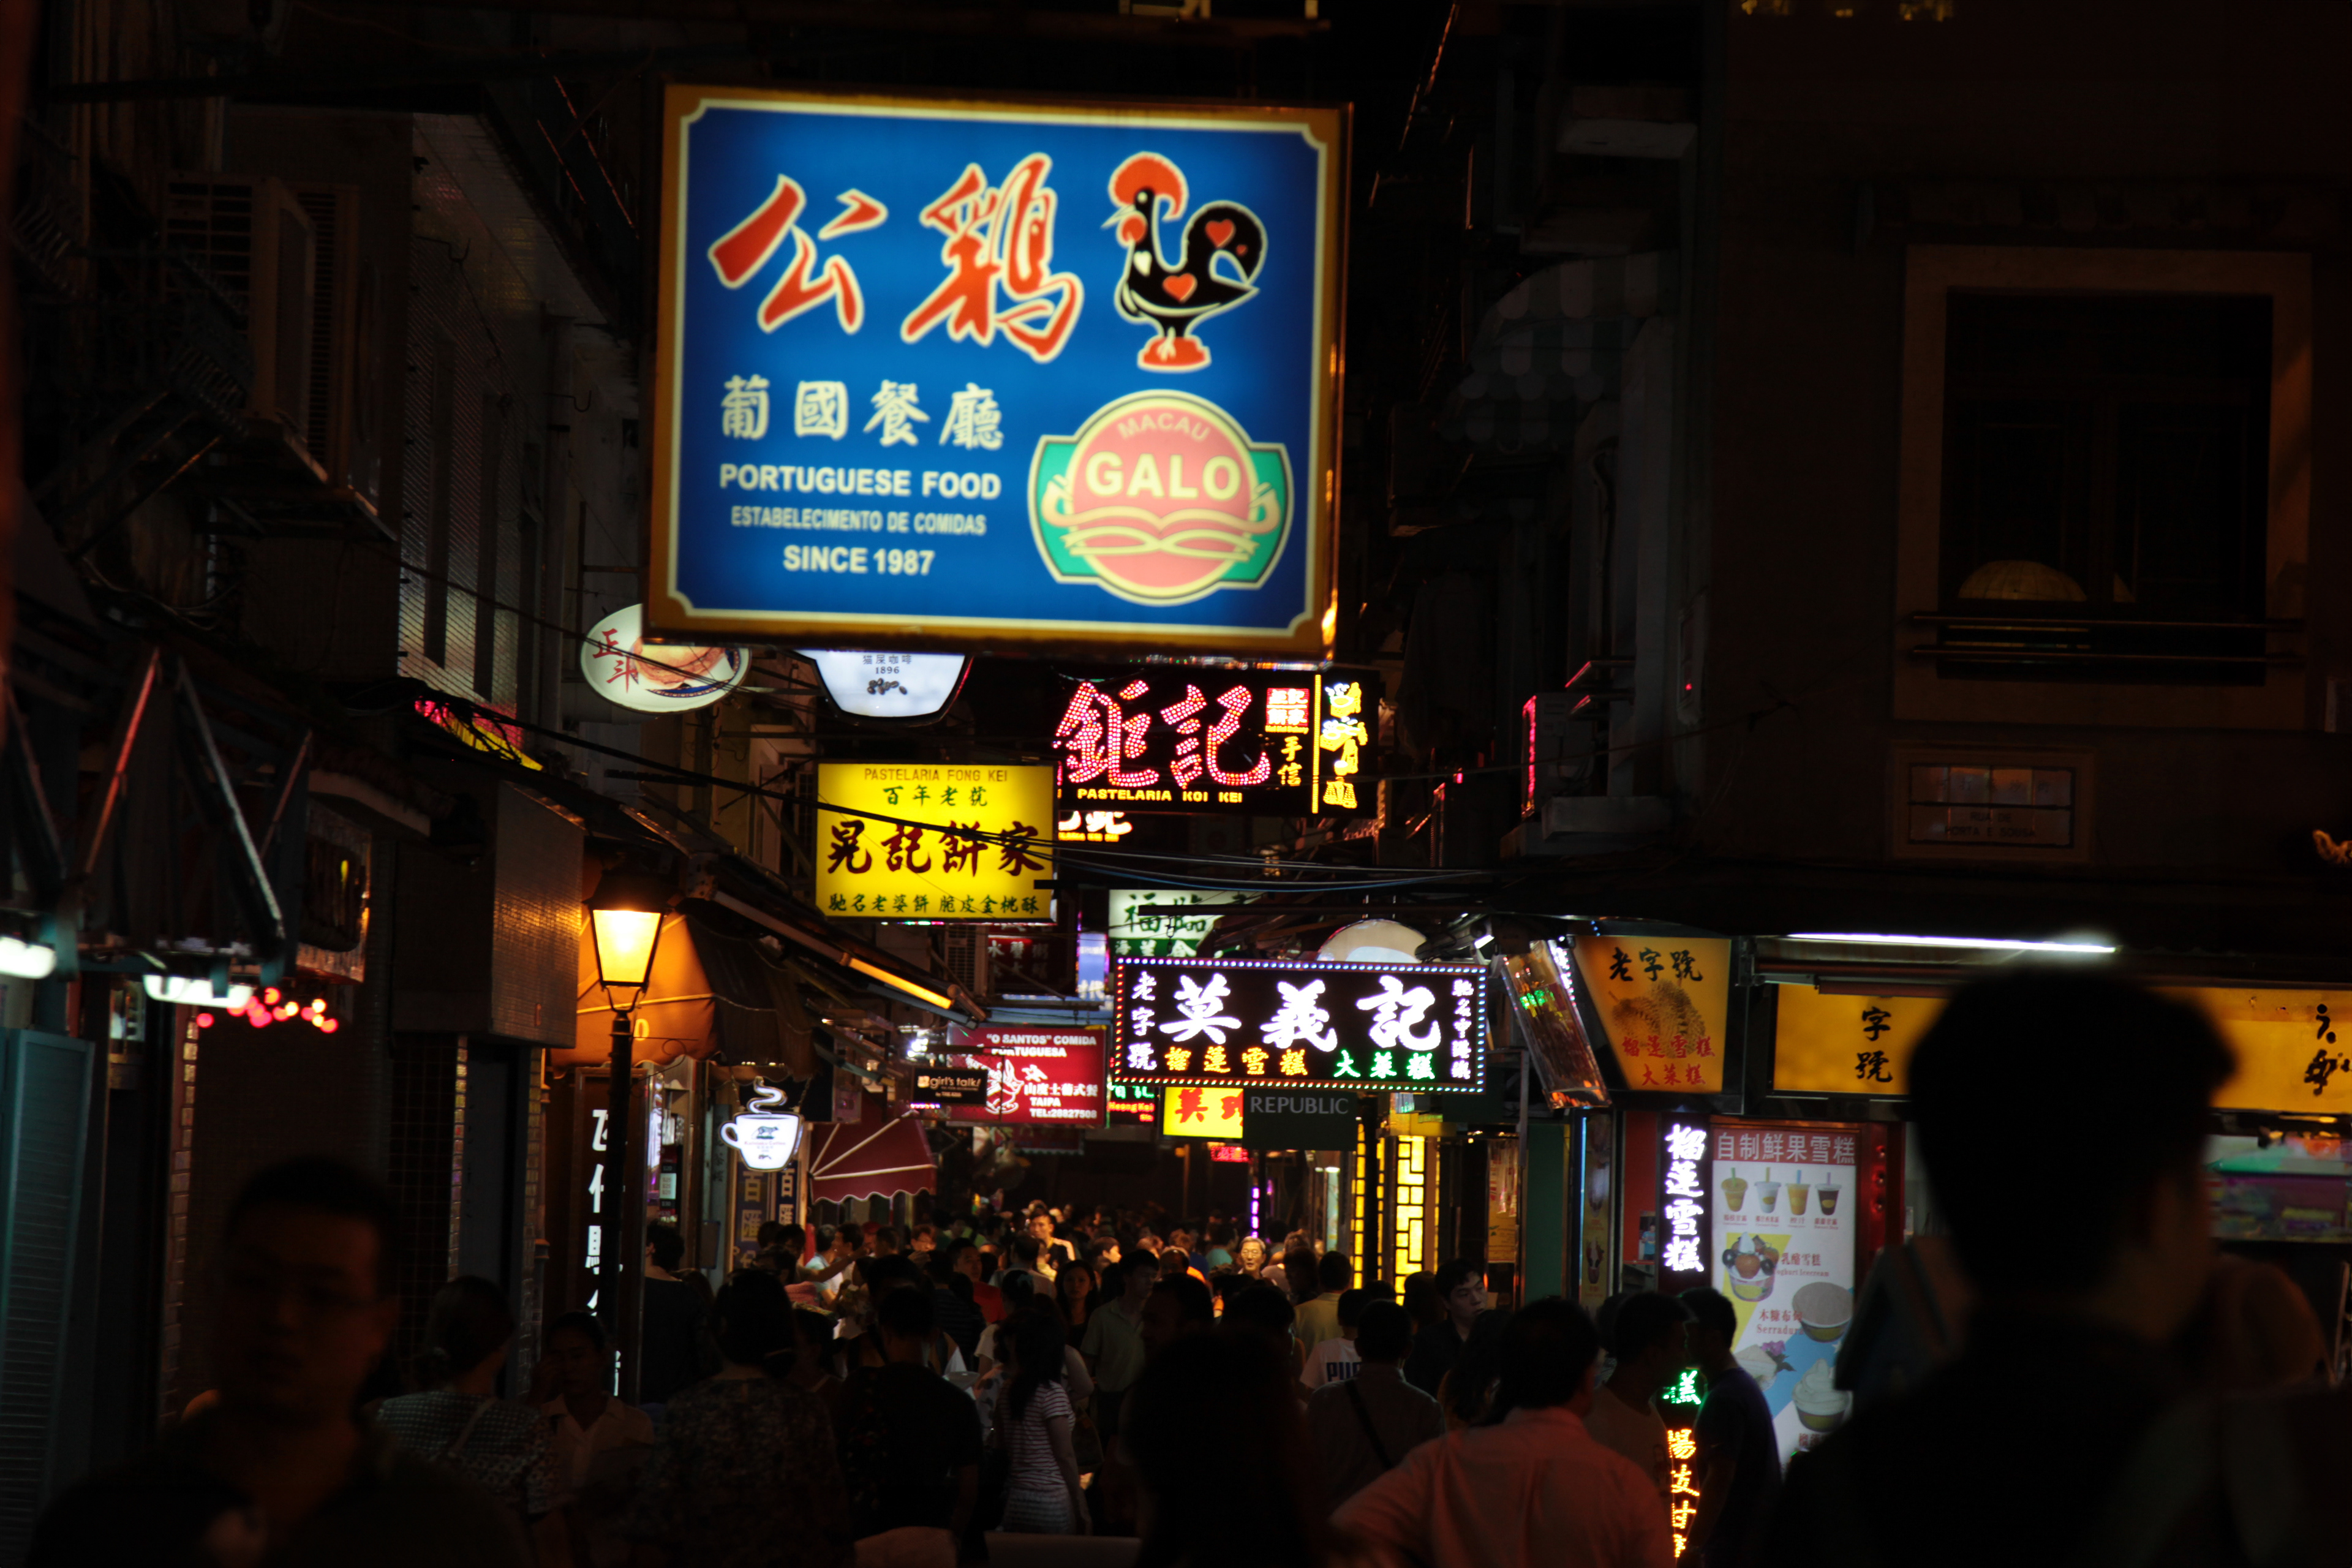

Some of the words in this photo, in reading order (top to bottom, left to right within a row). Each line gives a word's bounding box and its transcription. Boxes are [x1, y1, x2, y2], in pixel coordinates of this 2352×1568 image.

[720, 374, 1005, 451] 葡國餐廳
[1117, 412, 1210, 442] MACAU
[719, 462, 912, 497] PORTUGUESE
[921, 470, 1002, 500] FOOD
[1085, 450, 1242, 502] GALO
[731, 505, 883, 533] ESTABELECIMENTO
[887, 511, 910, 534] DE
[914, 513, 987, 537] COMIDAS
[783, 545, 869, 574] SINCE
[873, 548, 936, 576] 1987
[864, 768, 940, 782] PASTELARIA
[947, 770, 980, 782] FONG
[988, 770, 1008, 782] KEI
[1278, 736, 1303, 786] 手信
[1077, 788, 1172, 801] PASTELARIA
[1182, 791, 1208, 802] KOI
[1218, 791, 1243, 804] KEI
[1608, 947, 1703, 982] 老字號
[1159, 971, 1442, 1052] 莫義記
[1054, 1036, 1097, 1046] COMIDA
[1030, 1097, 1061, 1107] TAIPA
[1250, 1096, 1348, 1114] REPUBLIC
[1717, 1132, 1856, 1164] 自制鮮果雪糕
